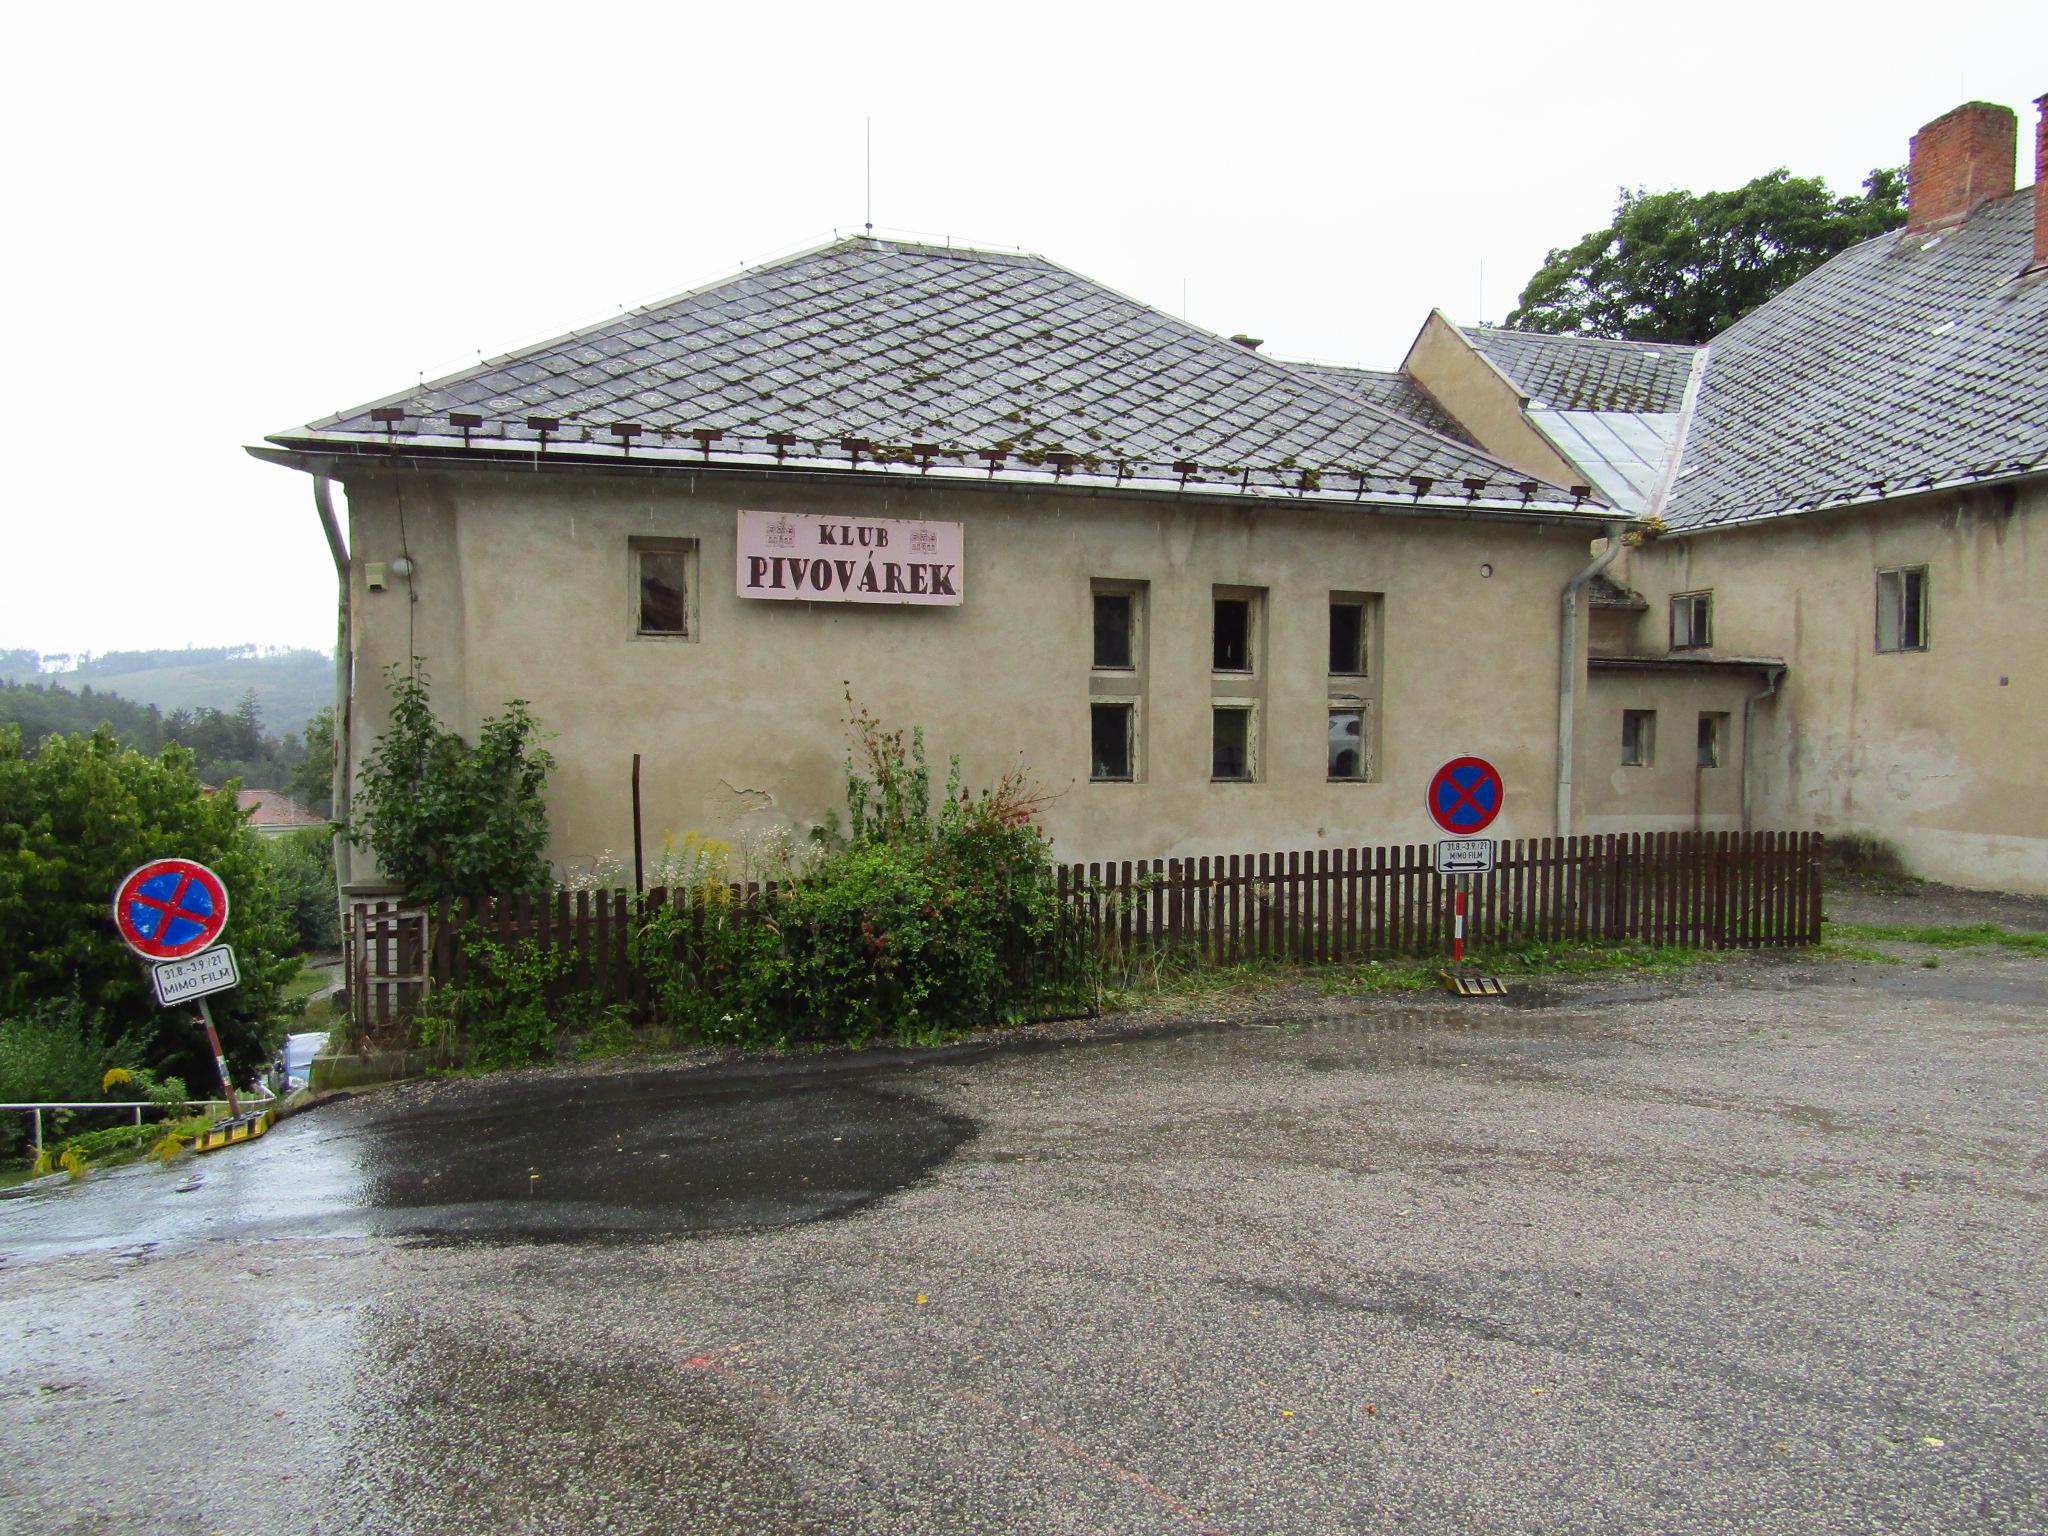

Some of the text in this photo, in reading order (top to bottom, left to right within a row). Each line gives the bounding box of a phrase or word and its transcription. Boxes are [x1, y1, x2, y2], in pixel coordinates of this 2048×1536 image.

[818, 524, 889, 548] KLUB
[746, 550, 957, 596] PIVOVÁREK
[1450, 851, 1483, 860] MIMO FILM
[164, 967, 231, 996] MIMO FILM
